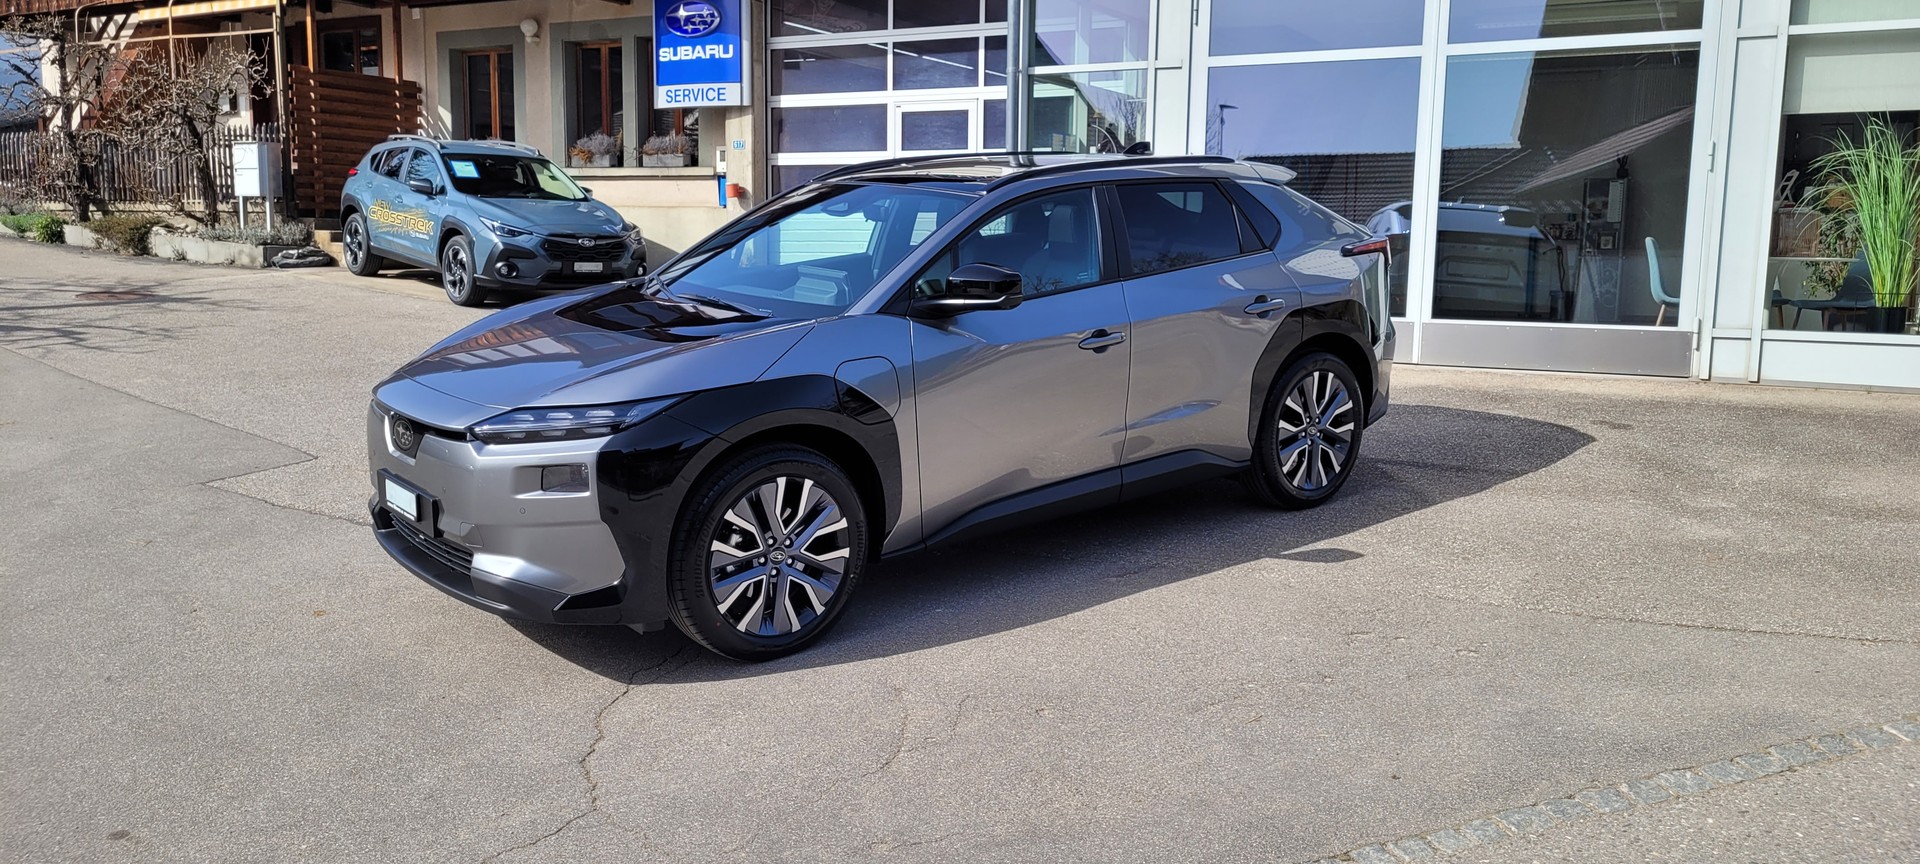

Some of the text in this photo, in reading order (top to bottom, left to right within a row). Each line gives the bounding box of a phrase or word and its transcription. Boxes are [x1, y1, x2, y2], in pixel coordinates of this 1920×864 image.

[659, 44, 734, 62] SUBARU
[666, 87, 727, 103] SERVICE
[374, 198, 392, 210] NEW
